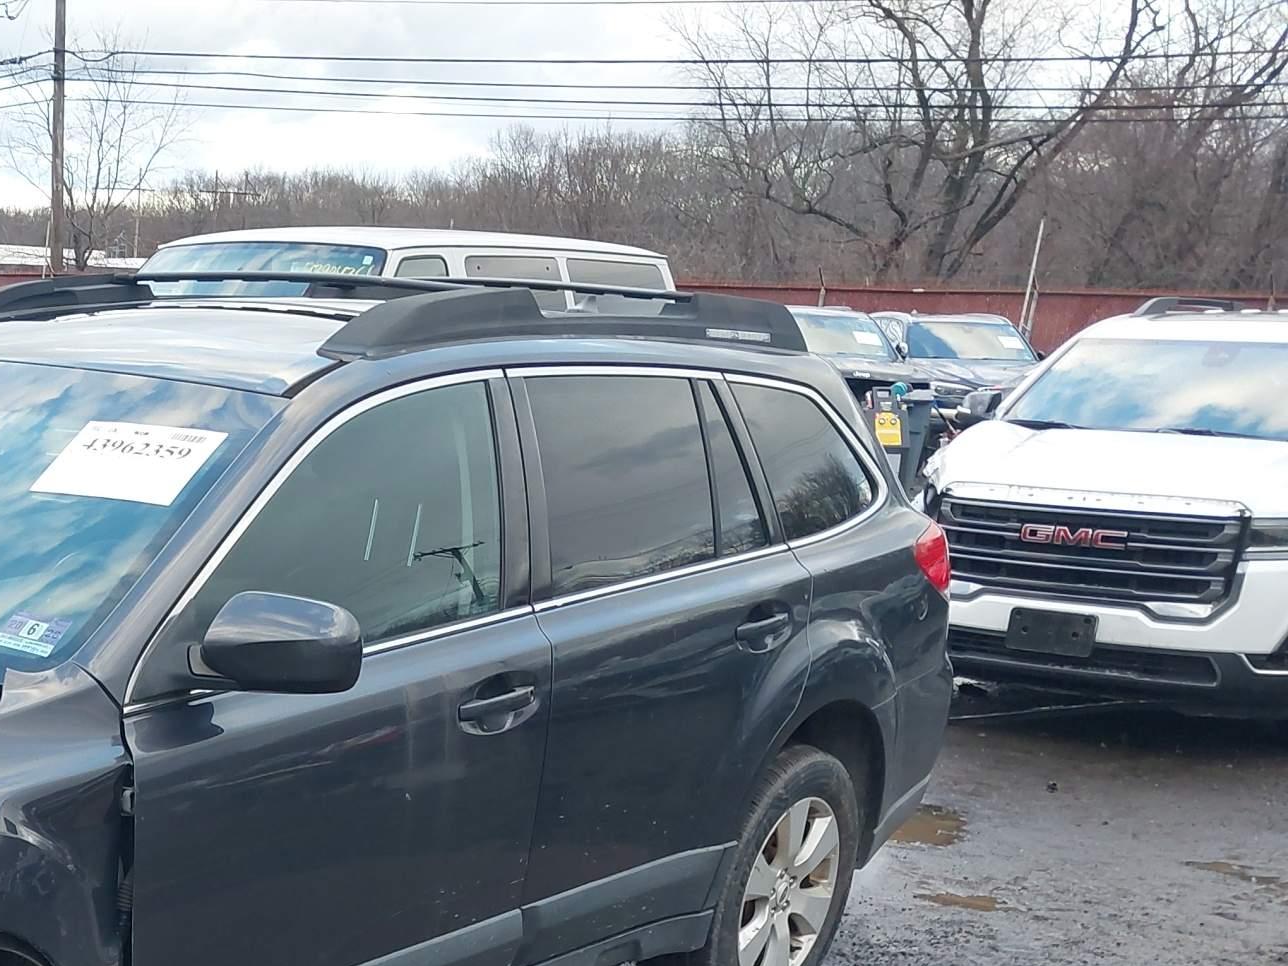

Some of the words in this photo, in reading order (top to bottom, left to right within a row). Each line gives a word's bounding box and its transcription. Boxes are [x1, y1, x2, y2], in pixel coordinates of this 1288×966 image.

[853, 370, 871, 378] Jeep
[82, 437, 193, 461] 43962359
[1020, 523, 1128, 550] GMC
[27, 623, 40, 636] 6
